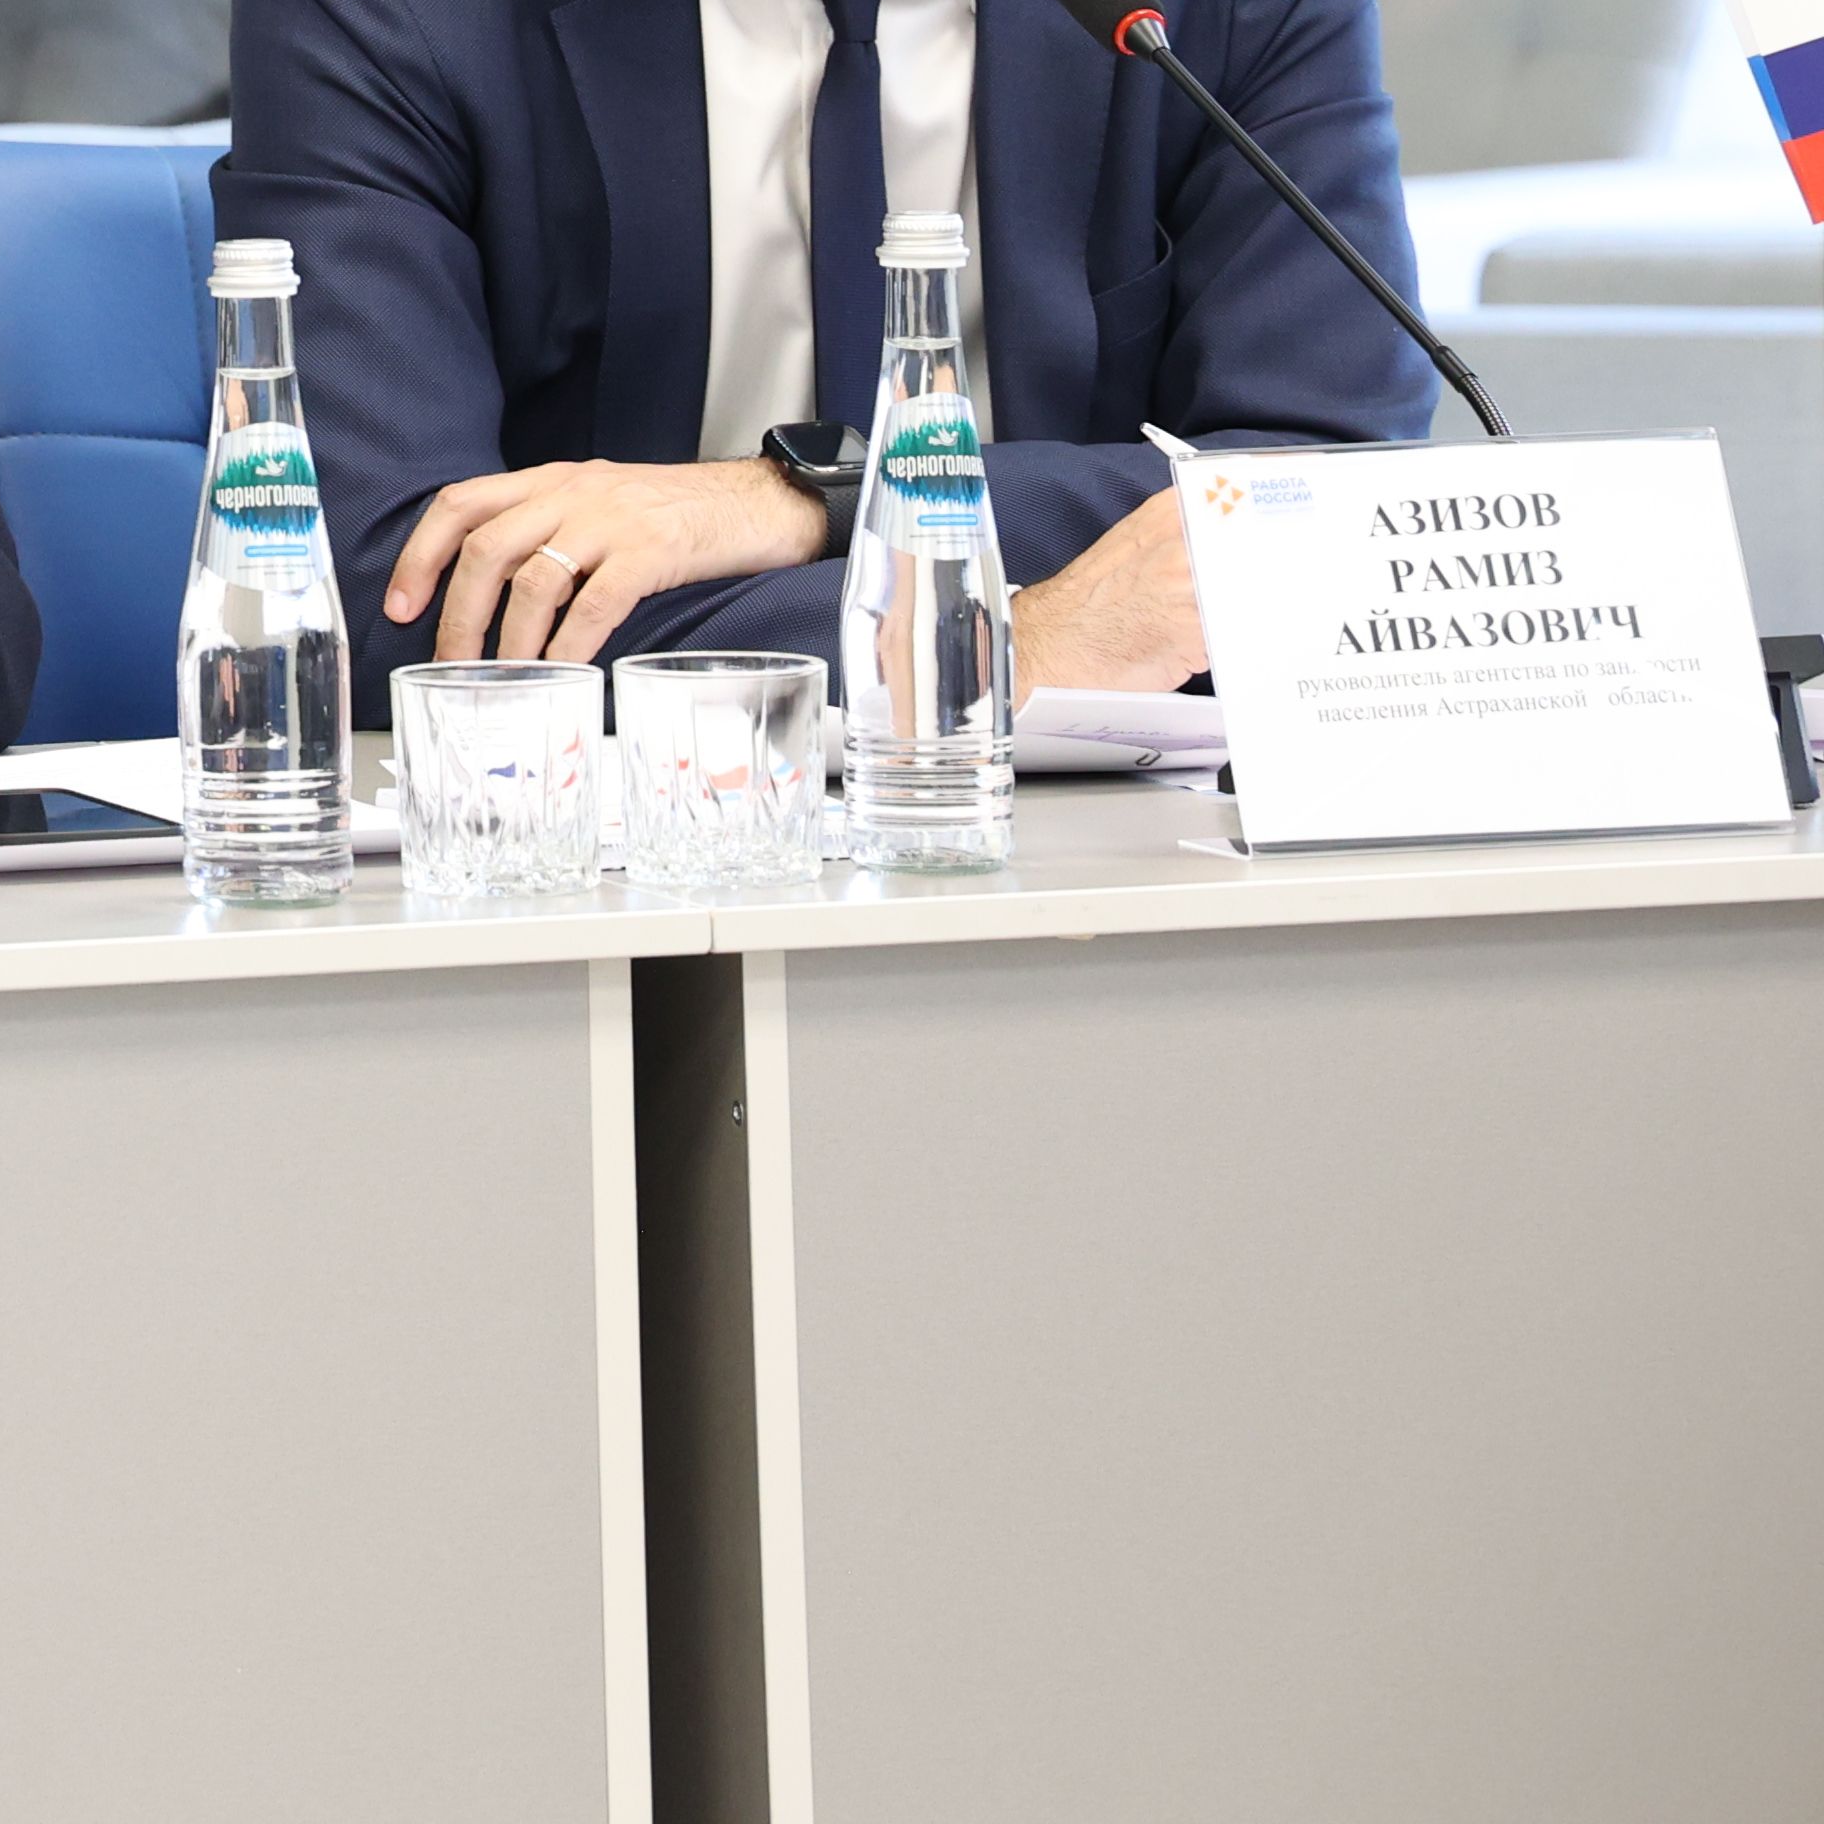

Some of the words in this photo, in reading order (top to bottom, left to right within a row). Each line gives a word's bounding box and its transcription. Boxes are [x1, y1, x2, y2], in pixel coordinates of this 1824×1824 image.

[1250, 477, 1307, 491] РАБОТА
[1253, 491, 1313, 504] РОССИИ
[1369, 492, 1562, 538] АЗИЗОВ
[1388, 549, 1564, 594] РАМИЗ
[1334, 604, 1644, 655] АЙВАЗОВИЧ
[1296, 669, 1447, 699] руководитель
[1453, 664, 1557, 686] агентства
[1564, 662, 1589, 678] по
[1318, 702, 1428, 723] населения
[1436, 689, 1587, 719] Астраханской
